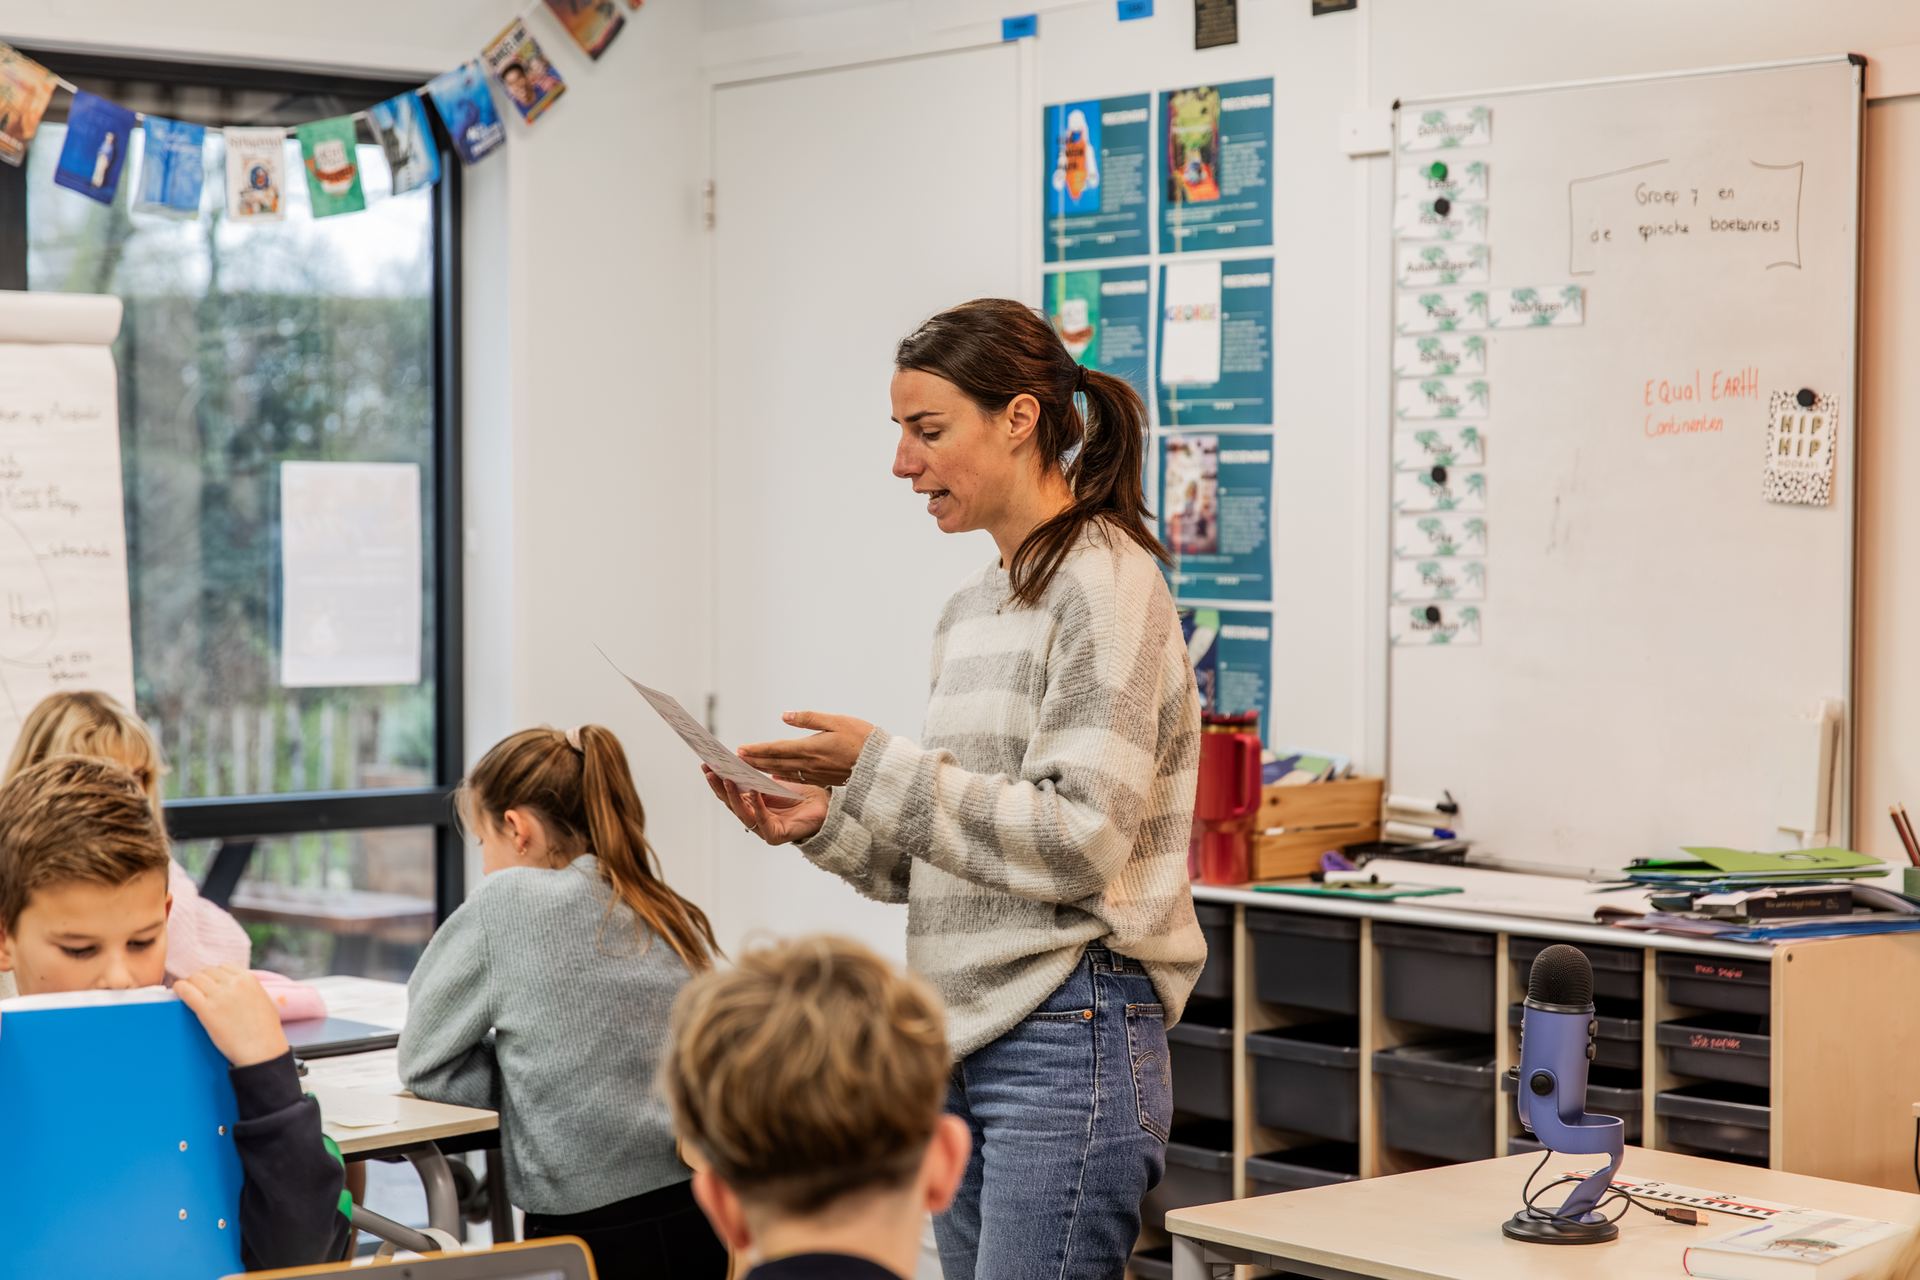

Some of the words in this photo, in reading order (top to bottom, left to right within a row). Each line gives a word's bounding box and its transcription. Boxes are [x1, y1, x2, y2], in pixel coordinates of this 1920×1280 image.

[1635, 182, 1680, 208] Groep
[1690, 188, 1698, 206] 7
[1717, 187, 1735, 200] en
[1590, 226, 1612, 243] de
[1780, 414, 1824, 435] HIP
[1778, 438, 1822, 458] HIP
